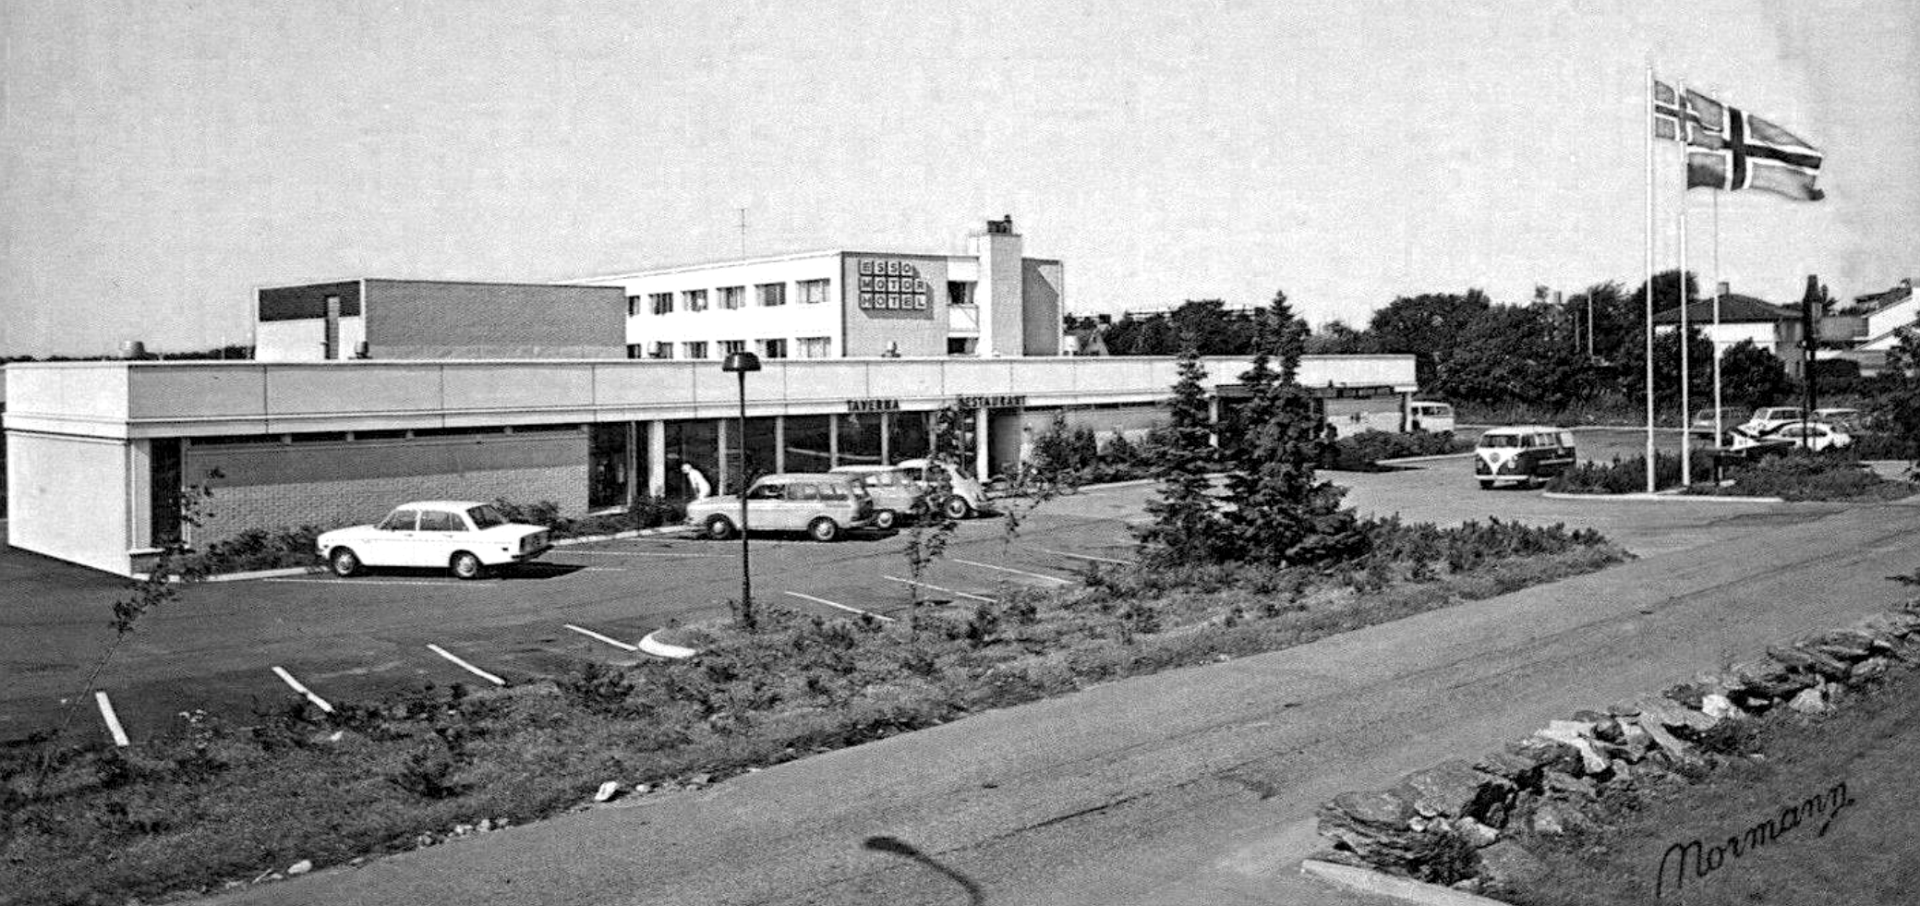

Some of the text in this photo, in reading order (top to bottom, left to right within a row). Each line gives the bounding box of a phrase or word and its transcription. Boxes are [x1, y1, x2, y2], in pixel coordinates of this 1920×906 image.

[861, 261, 913, 273] ESSO
[861, 279, 925, 291] MOTOR
[861, 295, 925, 308] HOTEL
[847, 399, 899, 411] TAVERNA
